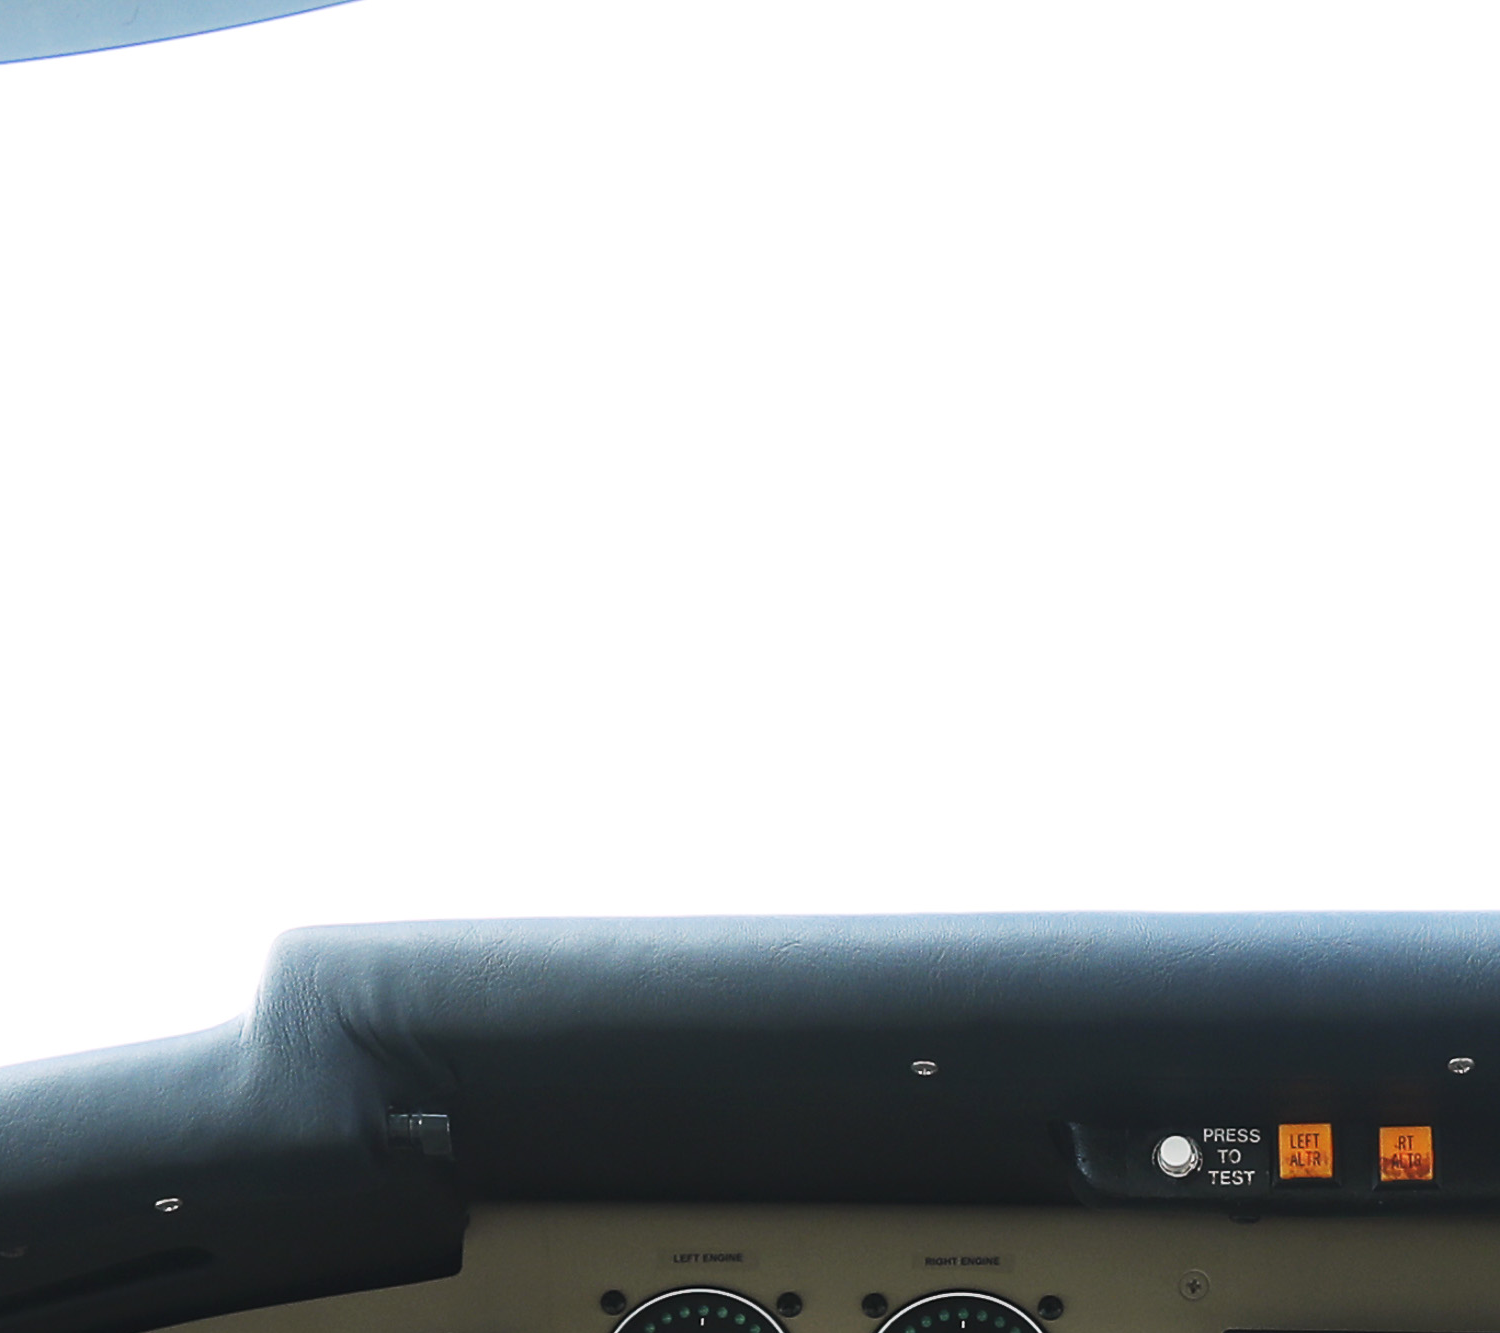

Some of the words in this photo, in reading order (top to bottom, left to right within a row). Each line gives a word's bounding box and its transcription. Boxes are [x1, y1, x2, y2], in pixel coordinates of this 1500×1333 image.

[1203, 1129, 1260, 1144] PRESS
[1290, 1134, 1320, 1148] LEFT
[1398, 1136, 1414, 1151] RT
[1218, 1149, 1241, 1164] TO
[1209, 1171, 1255, 1186] TEST
